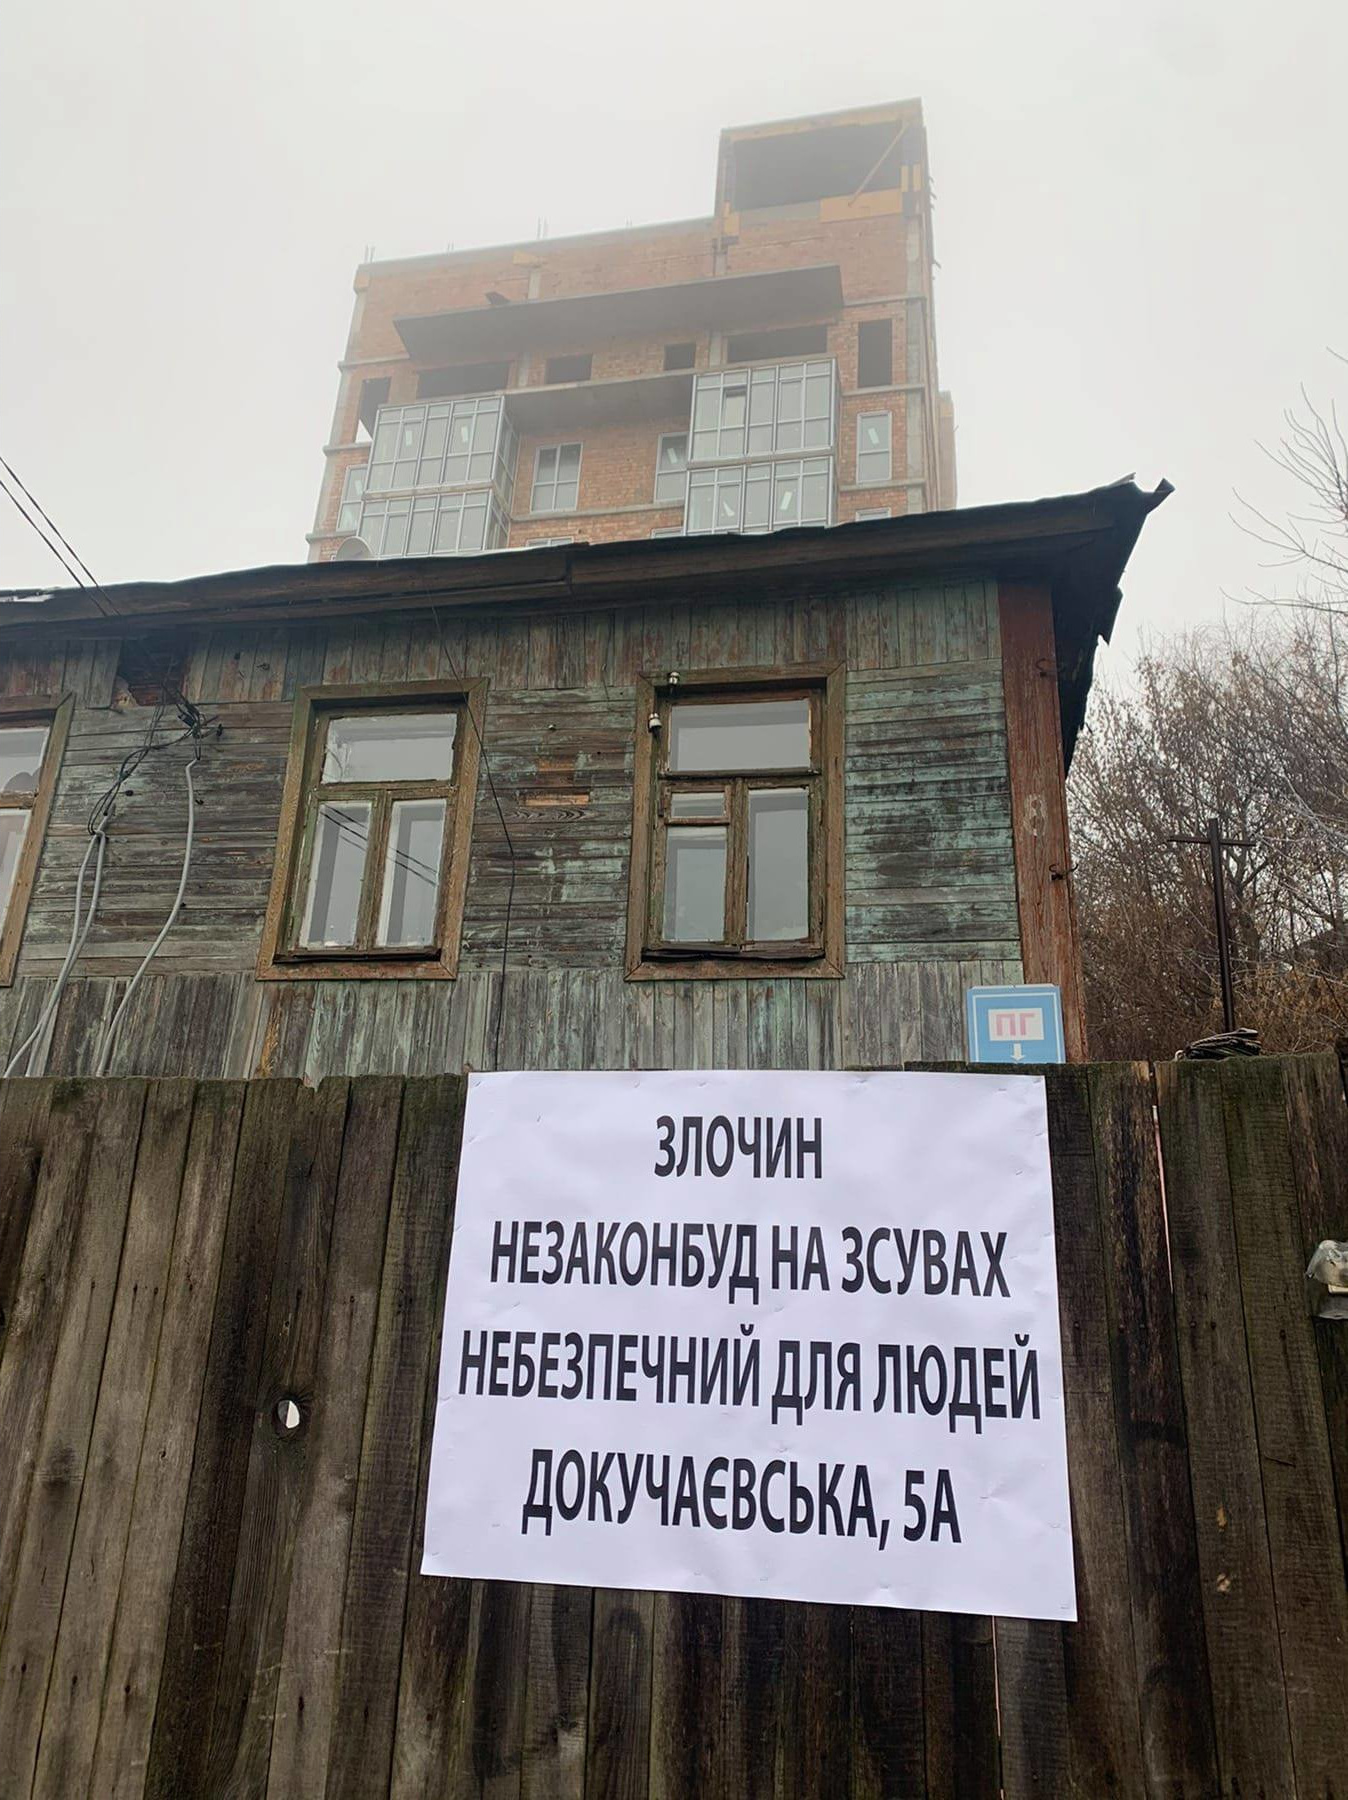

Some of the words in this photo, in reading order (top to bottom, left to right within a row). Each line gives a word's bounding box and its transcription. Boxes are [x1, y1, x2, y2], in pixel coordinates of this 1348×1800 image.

[995, 1012, 1036, 1036] ПГ
[654, 1115, 823, 1179] ЗЛОЧИН
[490, 1220, 760, 1306] НЕЗАКОНБУД
[771, 1225, 830, 1291] НА
[841, 1226, 1011, 1298] ЗСУВАХ
[458, 1323, 761, 1408] НЕБЕЗПЕЧНИЙ
[770, 1339, 861, 1427] ДЛЯ
[872, 1333, 1042, 1436] ЛЮДЕЙ
[521, 1448, 890, 1551] ДОКУЧАЄВСЬКА,
[902, 1468, 963, 1545] 5А
